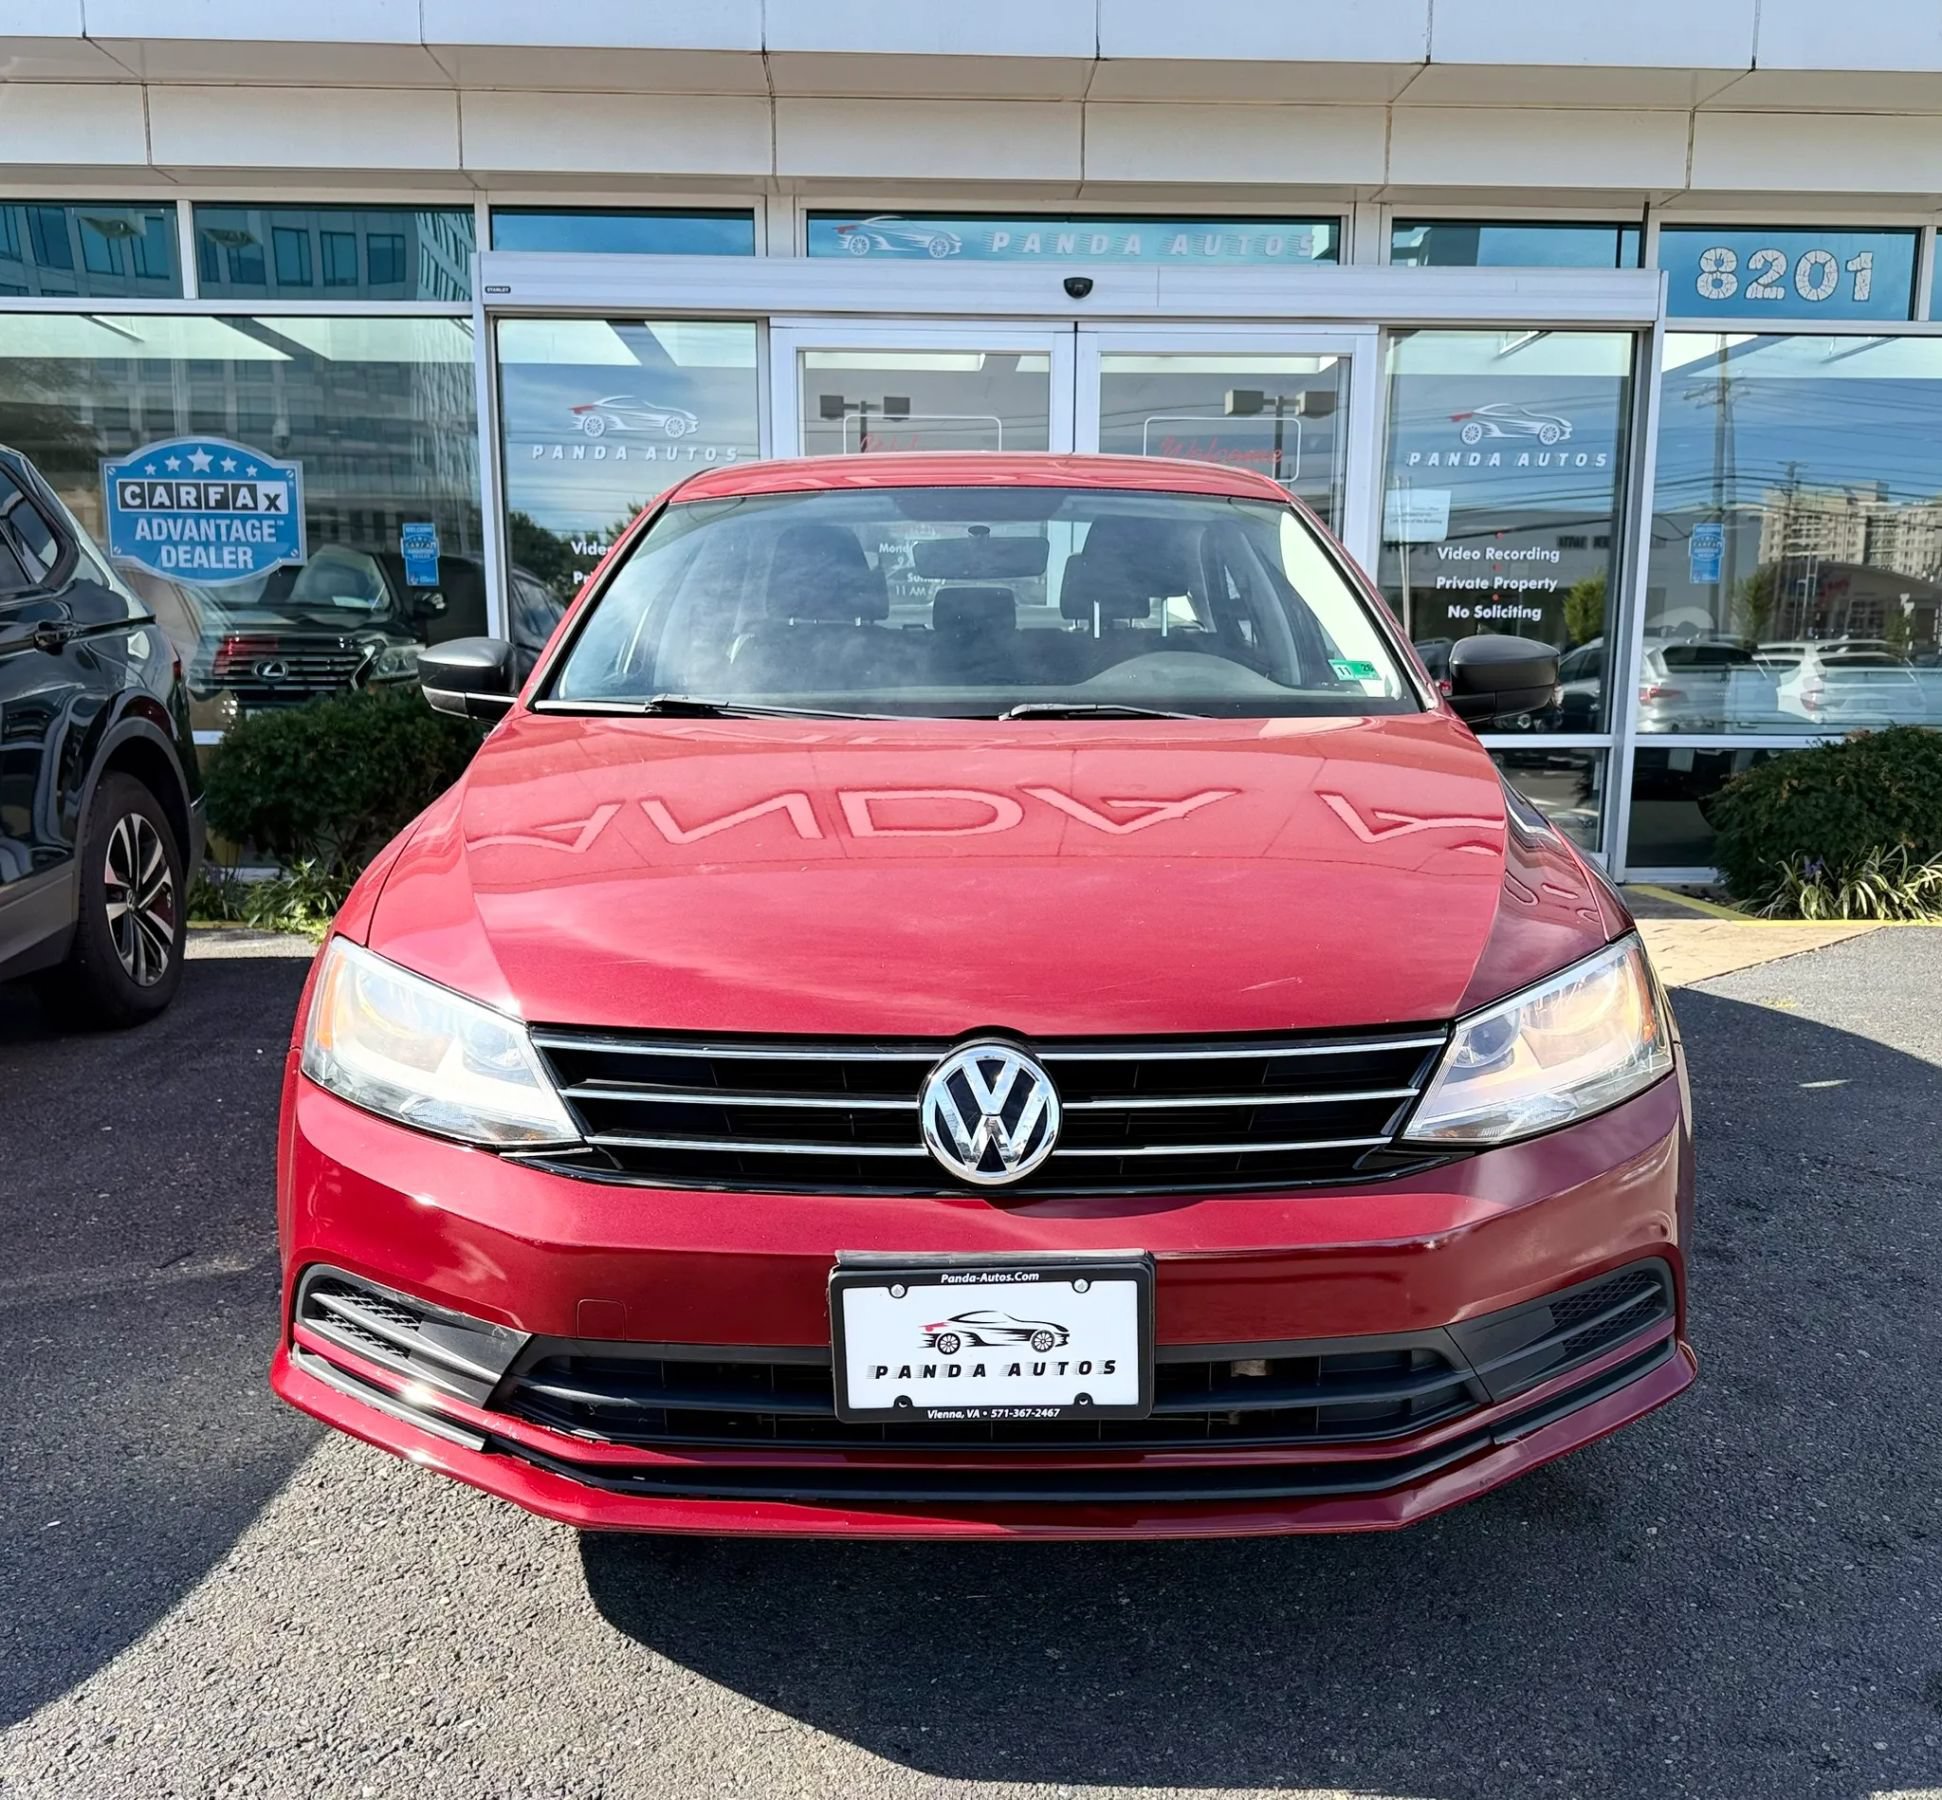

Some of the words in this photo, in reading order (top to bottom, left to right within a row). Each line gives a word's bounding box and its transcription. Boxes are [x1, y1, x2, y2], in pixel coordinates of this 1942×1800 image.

[988, 231, 1142, 255] PANDA
[1167, 233, 1316, 257] AUTOS
[1694, 246, 1874, 302] 8201
[531, 445, 628, 460] PANDA
[645, 446, 739, 461] AUTOS
[1407, 452, 1500, 467] PANDA
[1516, 452, 1608, 467] AUTOS
[123, 484, 282, 512] CARFAX
[134, 518, 277, 542] ADVANTAGE
[160, 545, 254, 569] DEALER
[1437, 547, 1481, 560] Video
[1485, 547, 1561, 563] Recording
[1435, 576, 1489, 590] Private
[1493, 576, 1559, 592] Property
[1447, 605, 1470, 619] No
[1473, 604, 1542, 621] Soliciting
[940, 1271, 1040, 1284] Panda-Autos.Com
[872, 1362, 987, 1380] PANDA
[1005, 1359, 1117, 1377] AUTOS
[926, 1409, 965, 1420] Vienna,
[966, 1408, 981, 1419] VA
[990, 1408, 1061, 1419] 571-367-2467
